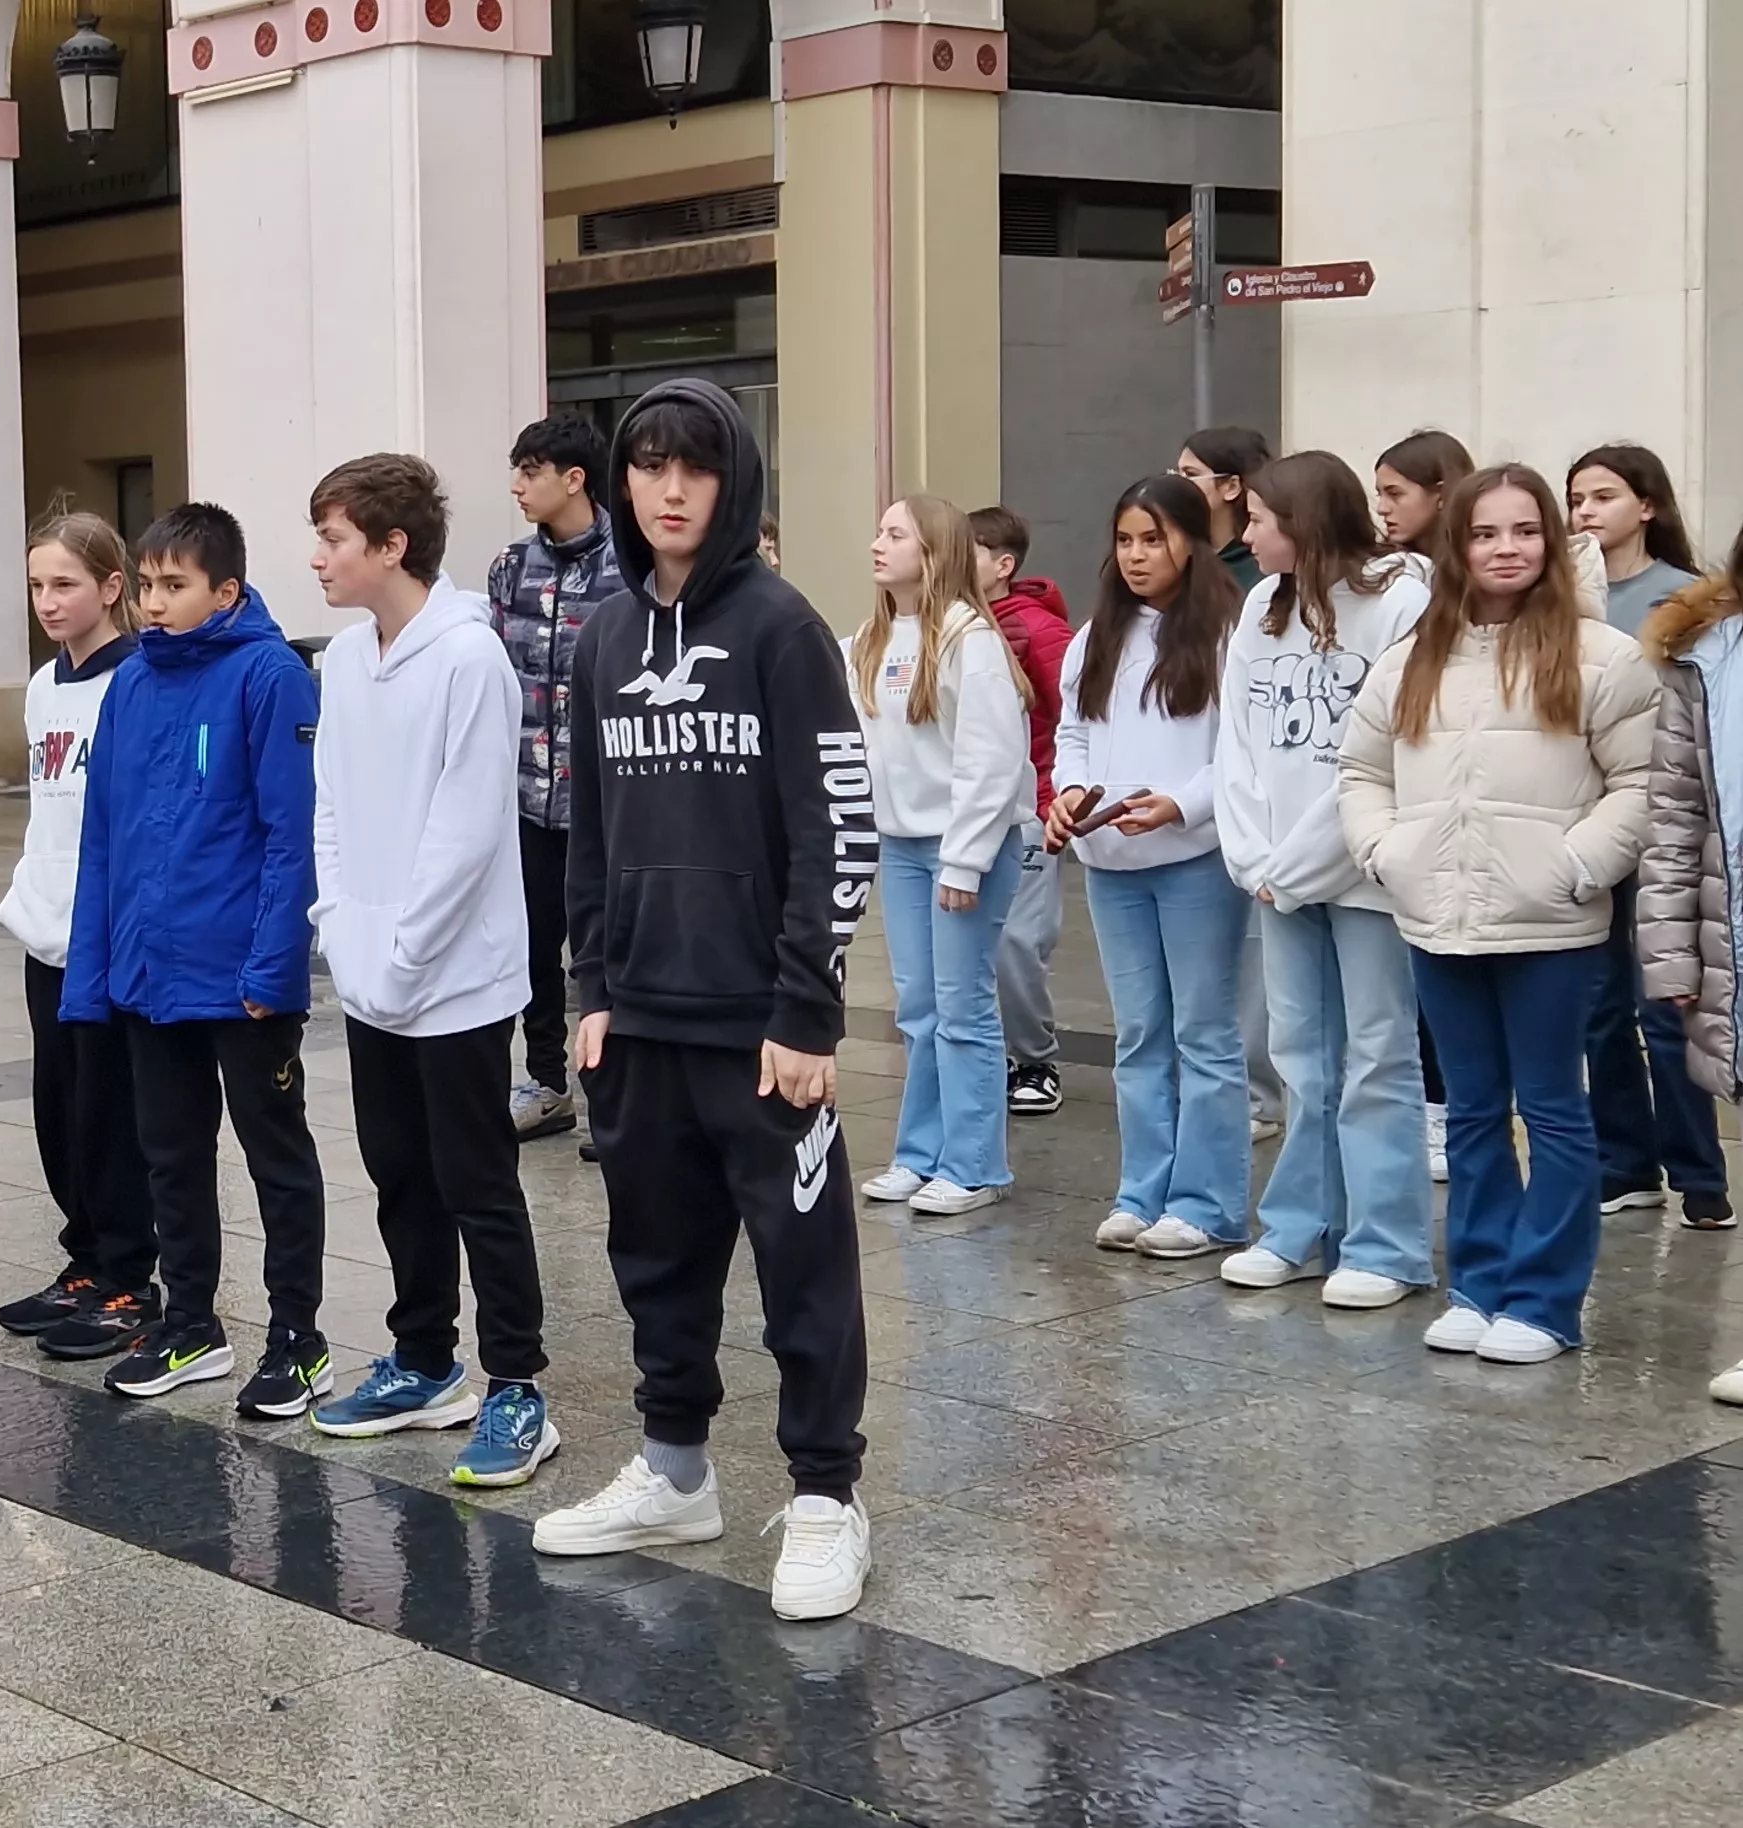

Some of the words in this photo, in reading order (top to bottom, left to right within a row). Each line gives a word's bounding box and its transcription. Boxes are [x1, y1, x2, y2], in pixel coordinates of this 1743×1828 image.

[1245, 286, 1257, 297] de
[1257, 285, 1274, 296] San
[1276, 284, 1302, 295] Pedro
[1312, 281, 1335, 294] Viejo
[601, 711, 762, 759] HOLLISTER
[616, 760, 749, 776] CALIFORNIA
